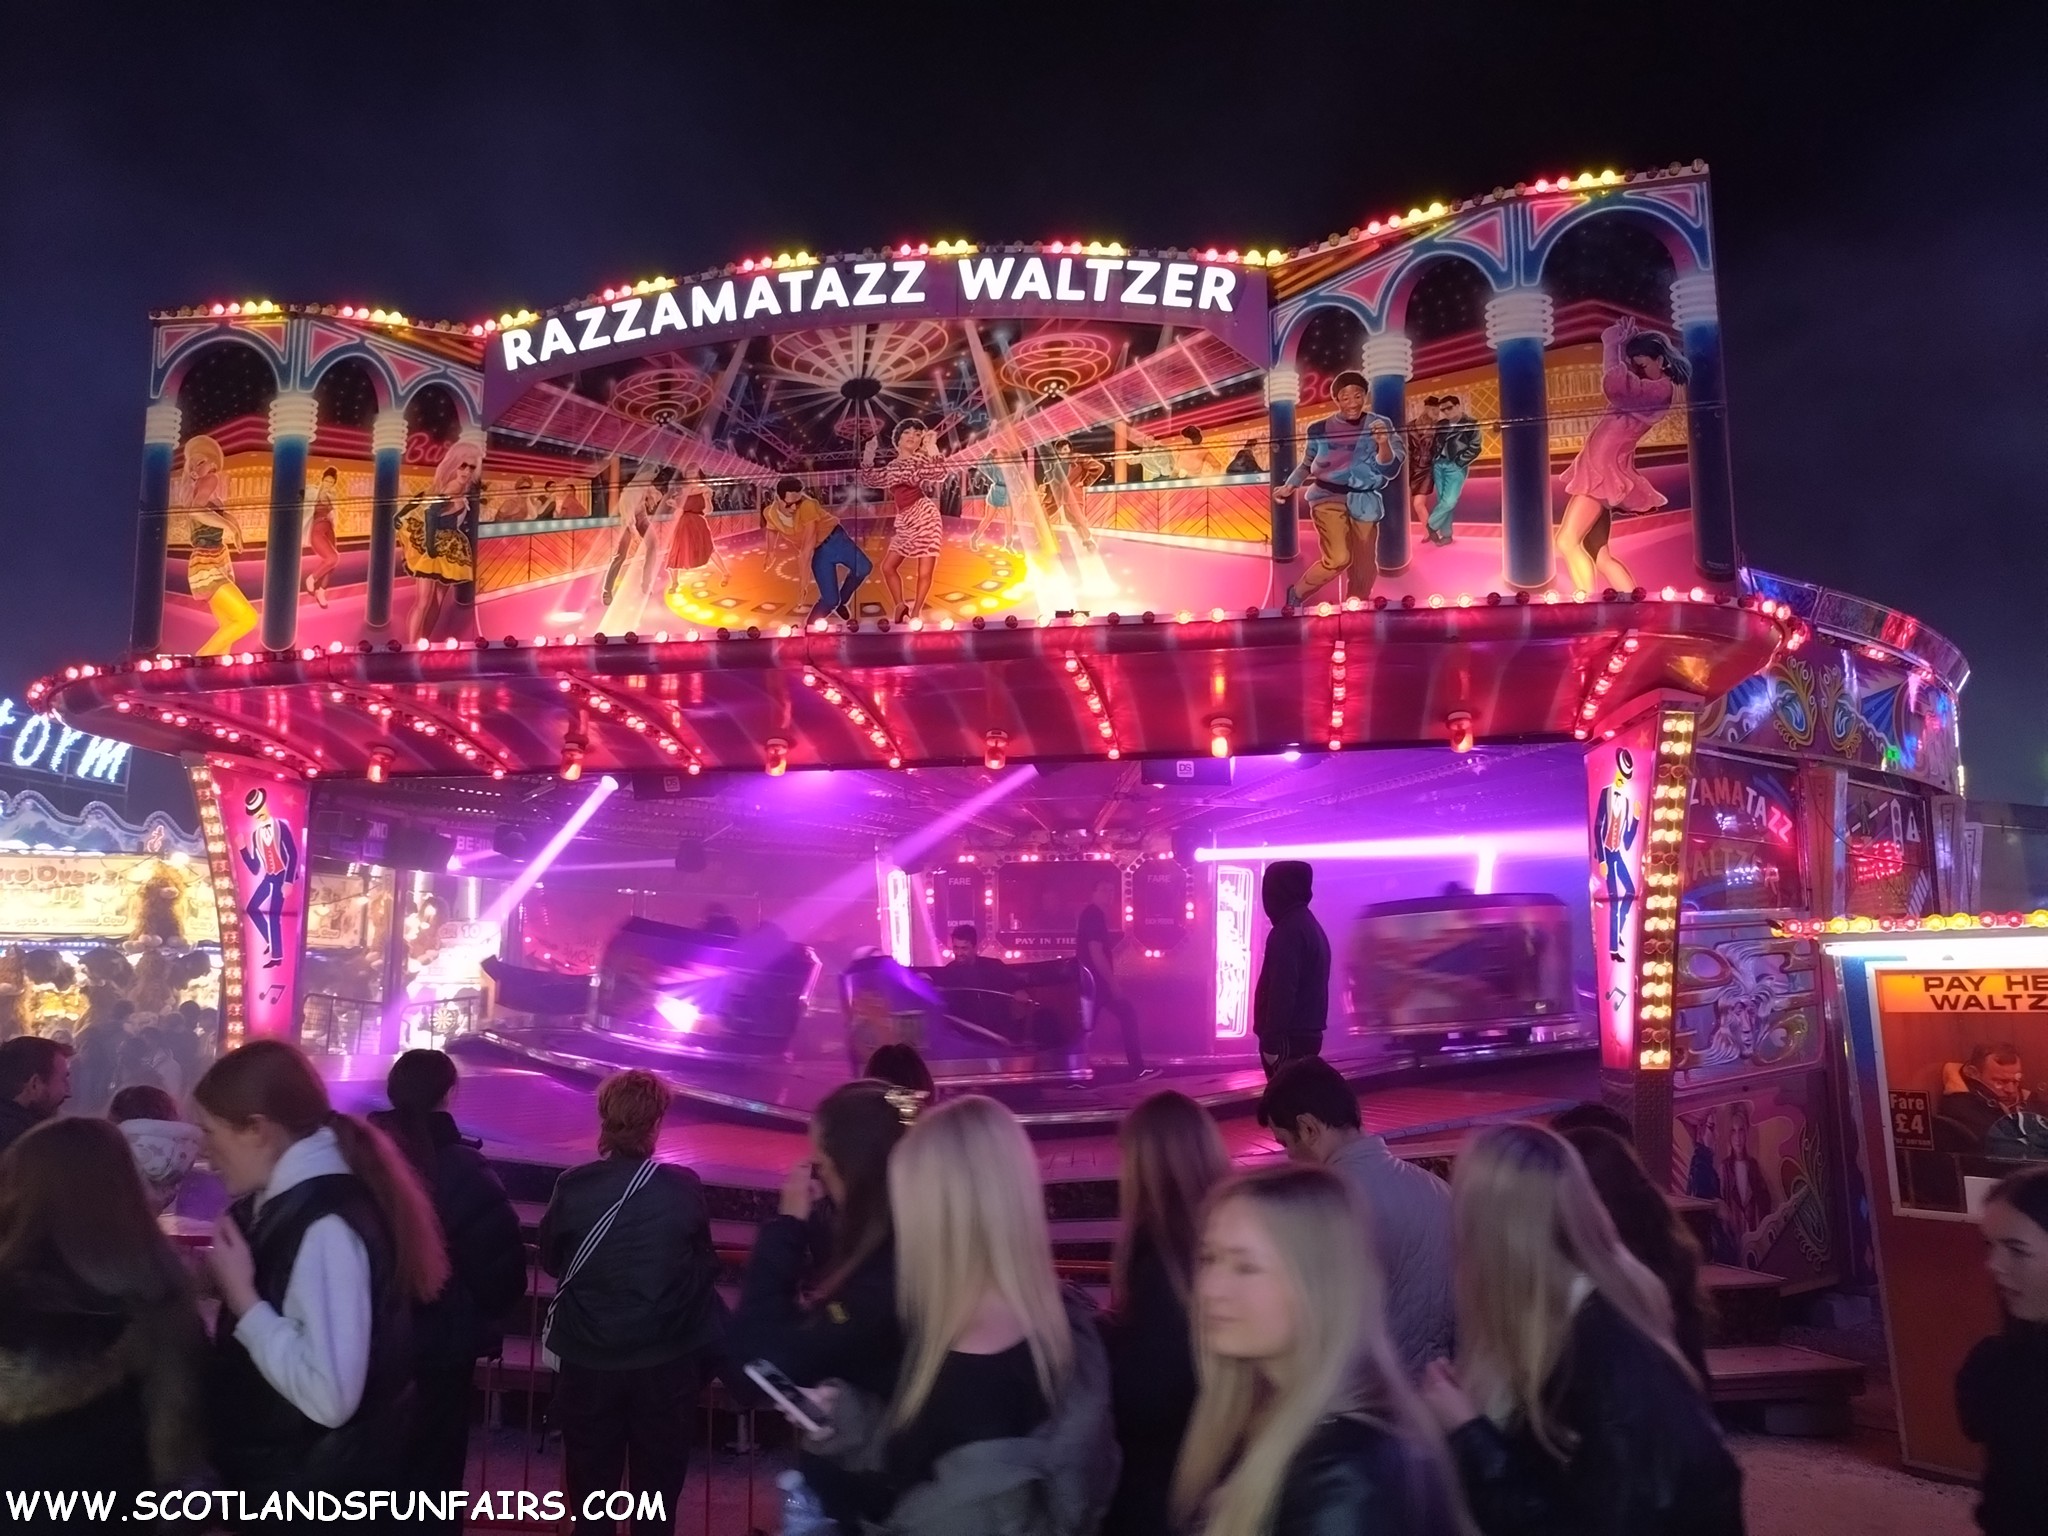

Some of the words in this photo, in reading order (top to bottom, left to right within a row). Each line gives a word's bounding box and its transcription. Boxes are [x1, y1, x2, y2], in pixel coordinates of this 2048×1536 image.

[501, 258, 927, 371] RAZZAMATAZZ
[958, 257, 1237, 313] WALTZER
[37, 866, 99, 884] Over
[1147, 874, 1171, 883] FARE
[1685, 847, 1781, 896] ALTZER
[948, 877, 971, 886] FARE
[1015, 937, 1036, 945] PAY
[1040, 937, 1051, 945] IN
[1055, 937, 1077, 945] THE
[1923, 976, 1987, 992] PAY
[2005, 975, 2048, 992] HE
[1930, 994, 2048, 1011] WALTZ
[1890, 1093, 1925, 1110] Fare
[1895, 1113, 1925, 1134] £4
